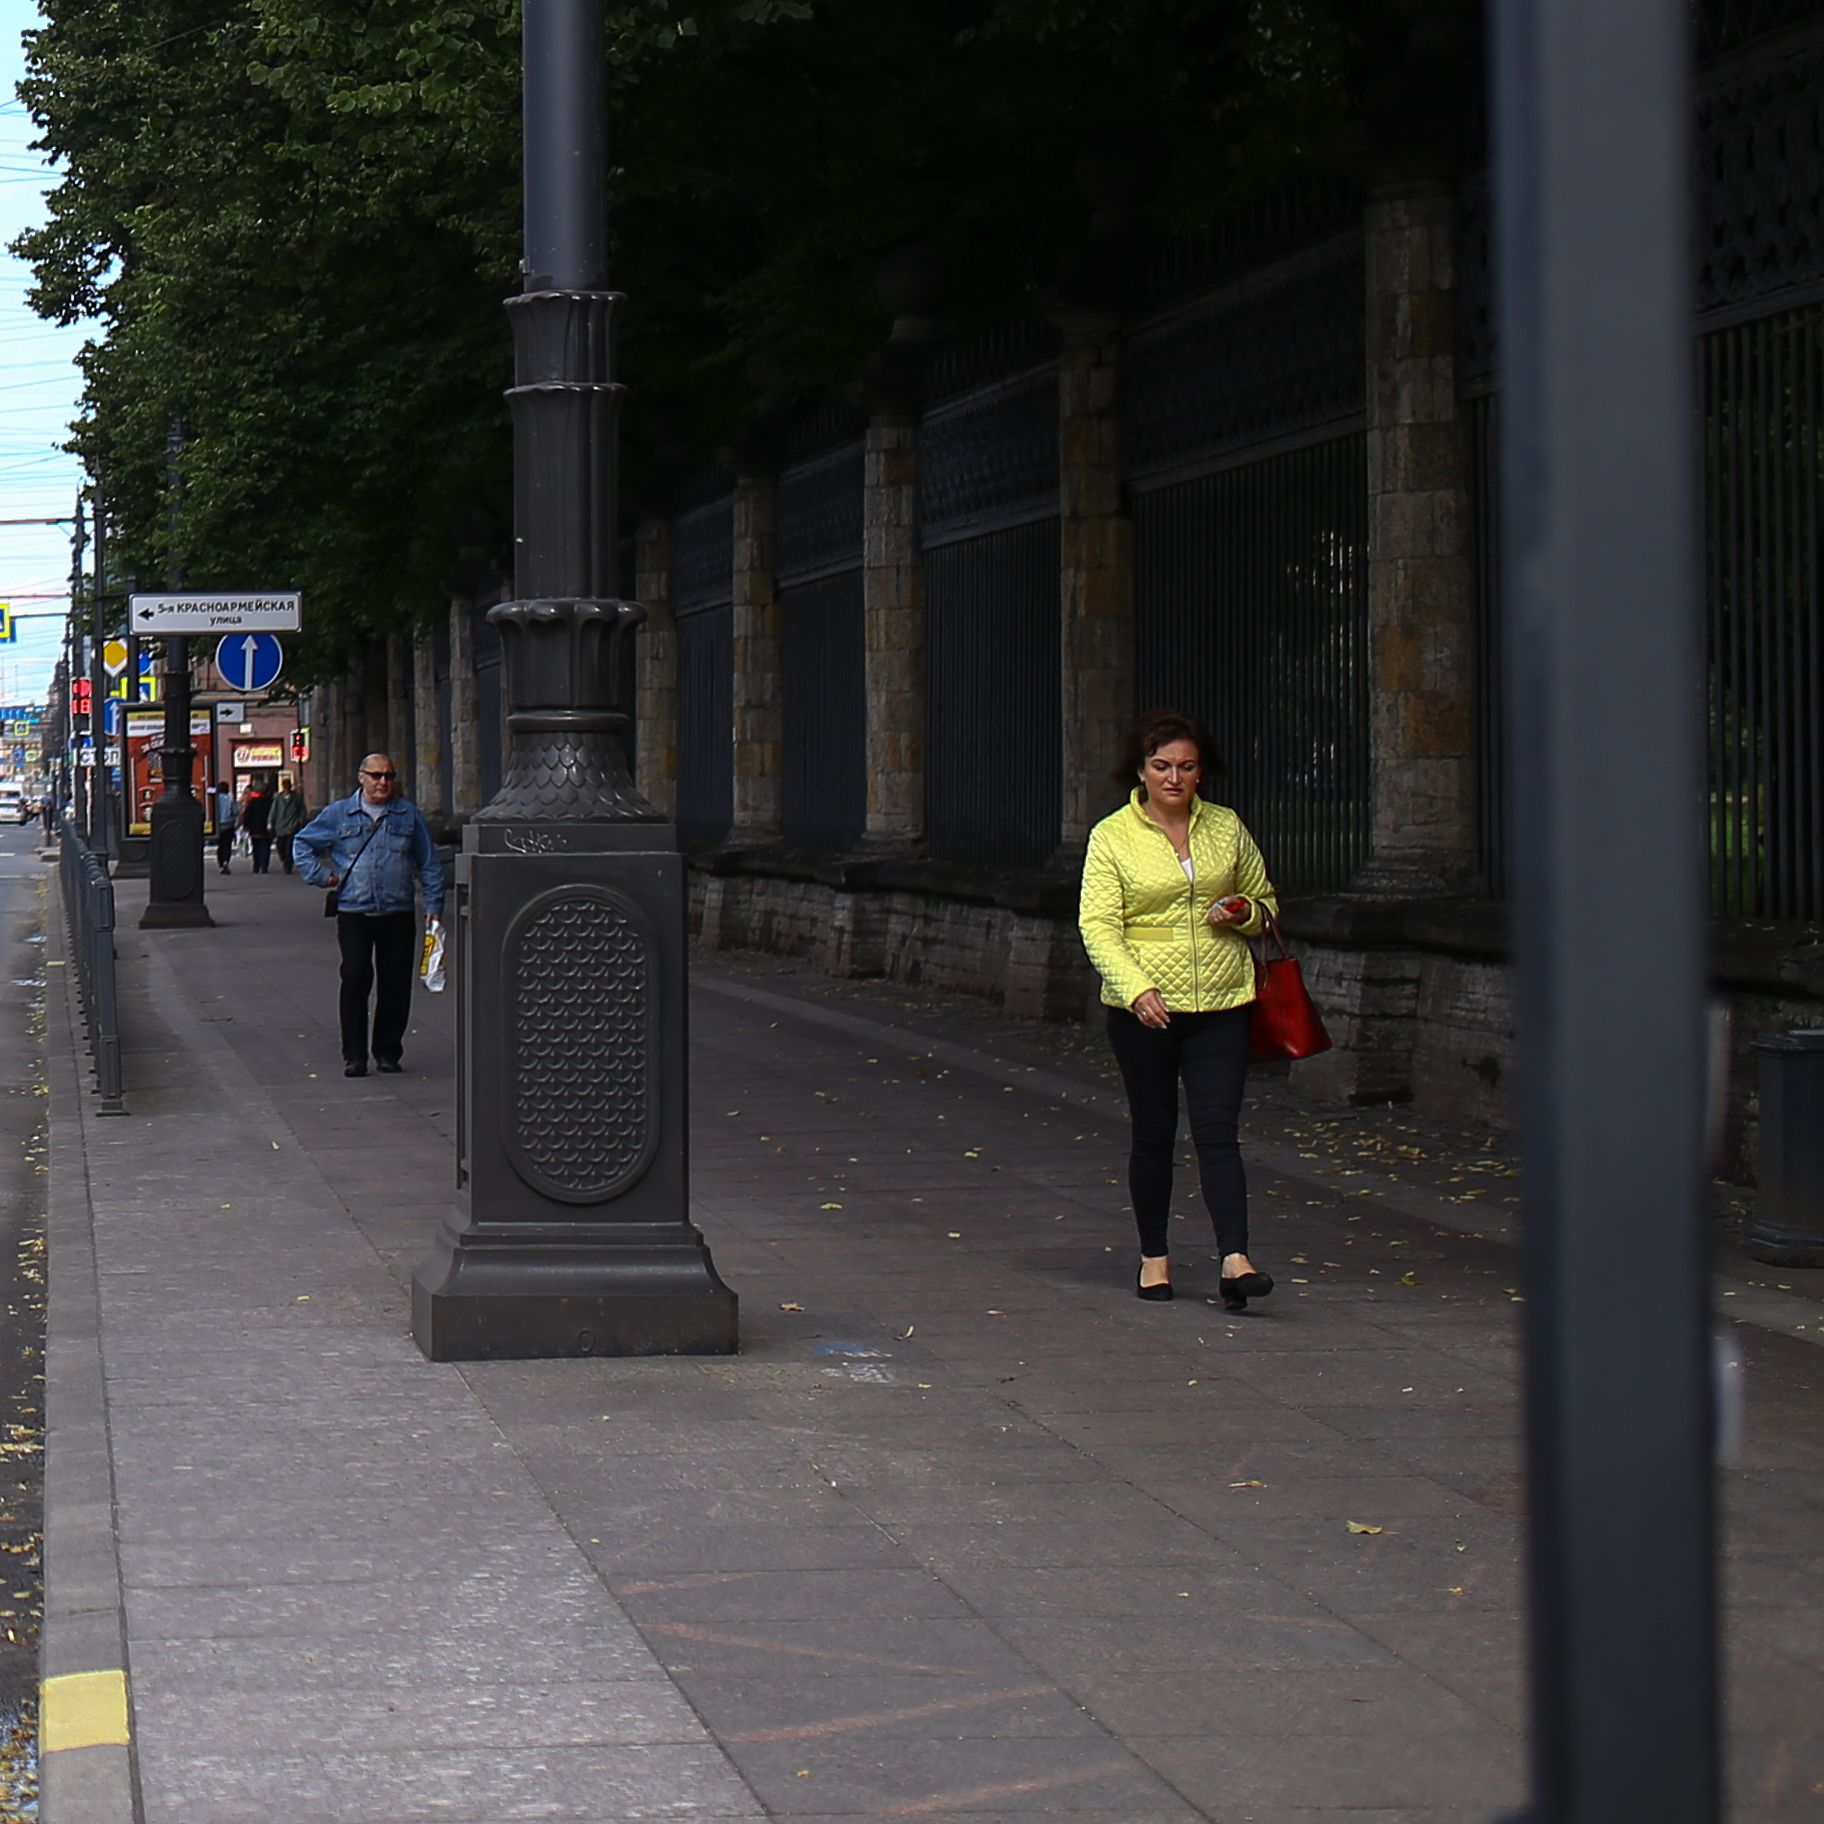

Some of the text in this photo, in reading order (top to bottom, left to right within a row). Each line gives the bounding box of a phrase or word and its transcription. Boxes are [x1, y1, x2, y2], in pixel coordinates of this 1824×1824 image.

[158, 600, 295, 615] 5-я КРАСНОАРМЕЙСКАЯ
[209, 616, 243, 627] улица
